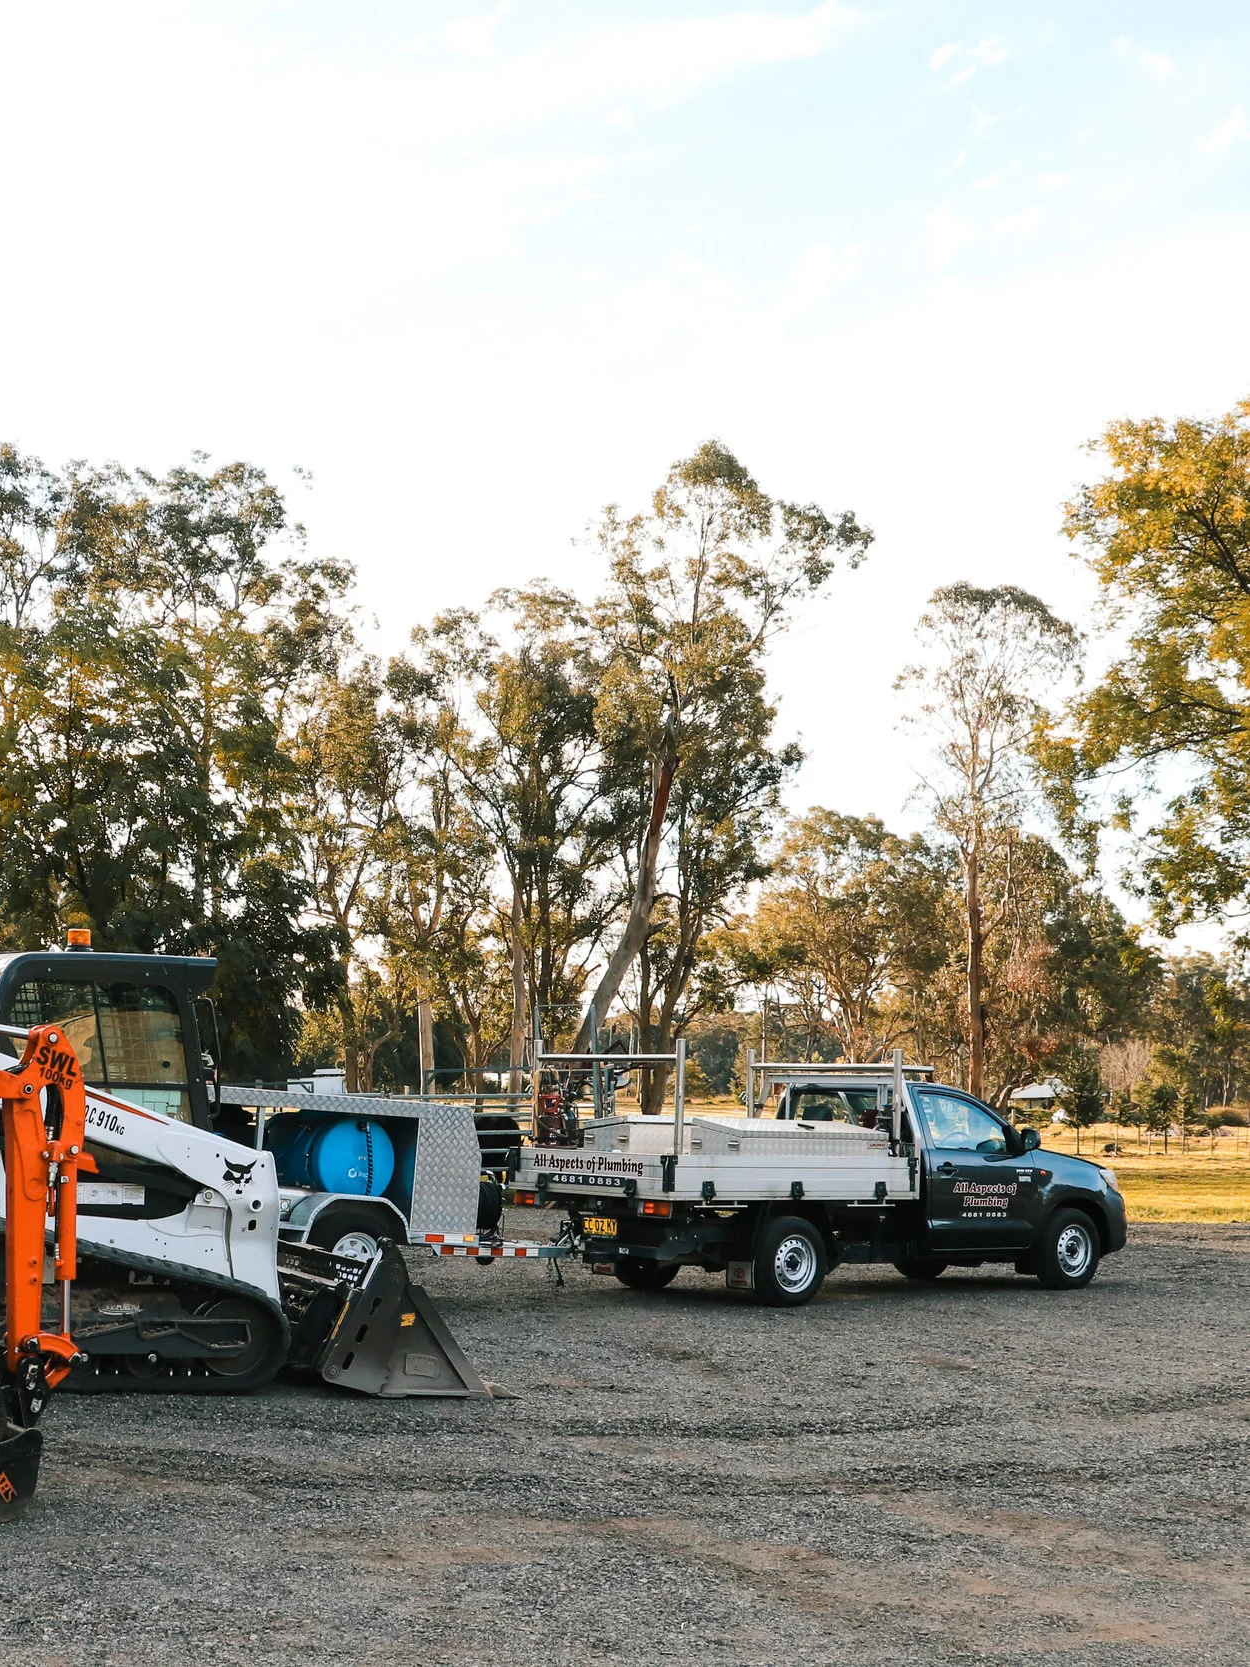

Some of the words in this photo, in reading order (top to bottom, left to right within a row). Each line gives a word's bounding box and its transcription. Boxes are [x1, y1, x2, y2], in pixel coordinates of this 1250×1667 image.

[36, 1046, 77, 1078] SWL
[39, 1066, 73, 1090] 100kg
[533, 1153, 547, 1167] All
[549, 1154, 584, 1171] Aspects
[586, 1156, 596, 1173] of
[597, 1156, 644, 1177] Plumbing
[552, 1174, 583, 1183] 4681
[588, 1176, 621, 1186] 0883
[953, 1182, 969, 1193] All
[969, 1182, 1006, 1195] Aspects
[1006, 1182, 1017, 1196] of
[963, 1196, 1009, 1209] Plumbing
